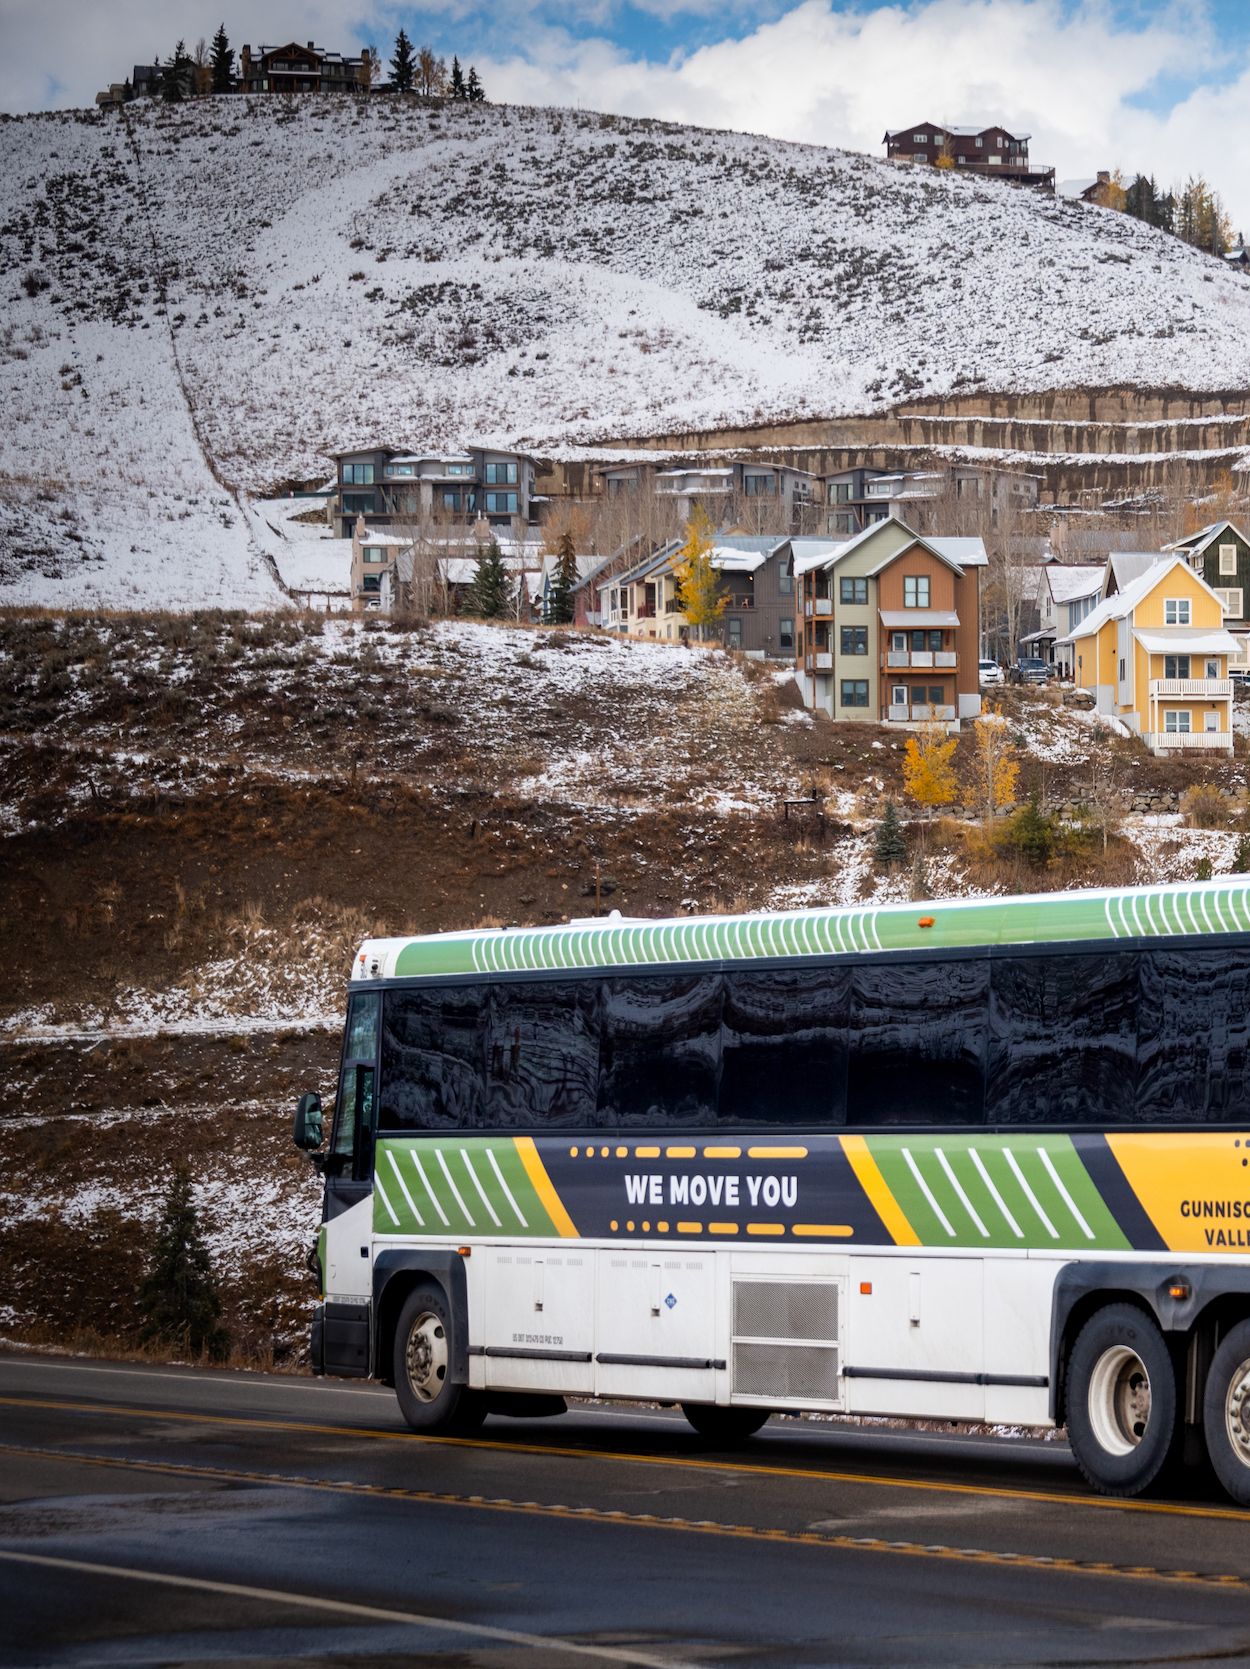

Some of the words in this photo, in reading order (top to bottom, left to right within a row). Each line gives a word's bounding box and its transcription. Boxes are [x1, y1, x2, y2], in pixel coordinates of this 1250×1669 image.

[624, 1175, 663, 1204] WE
[670, 1175, 740, 1206] MOVE
[746, 1176, 797, 1207] YOU
